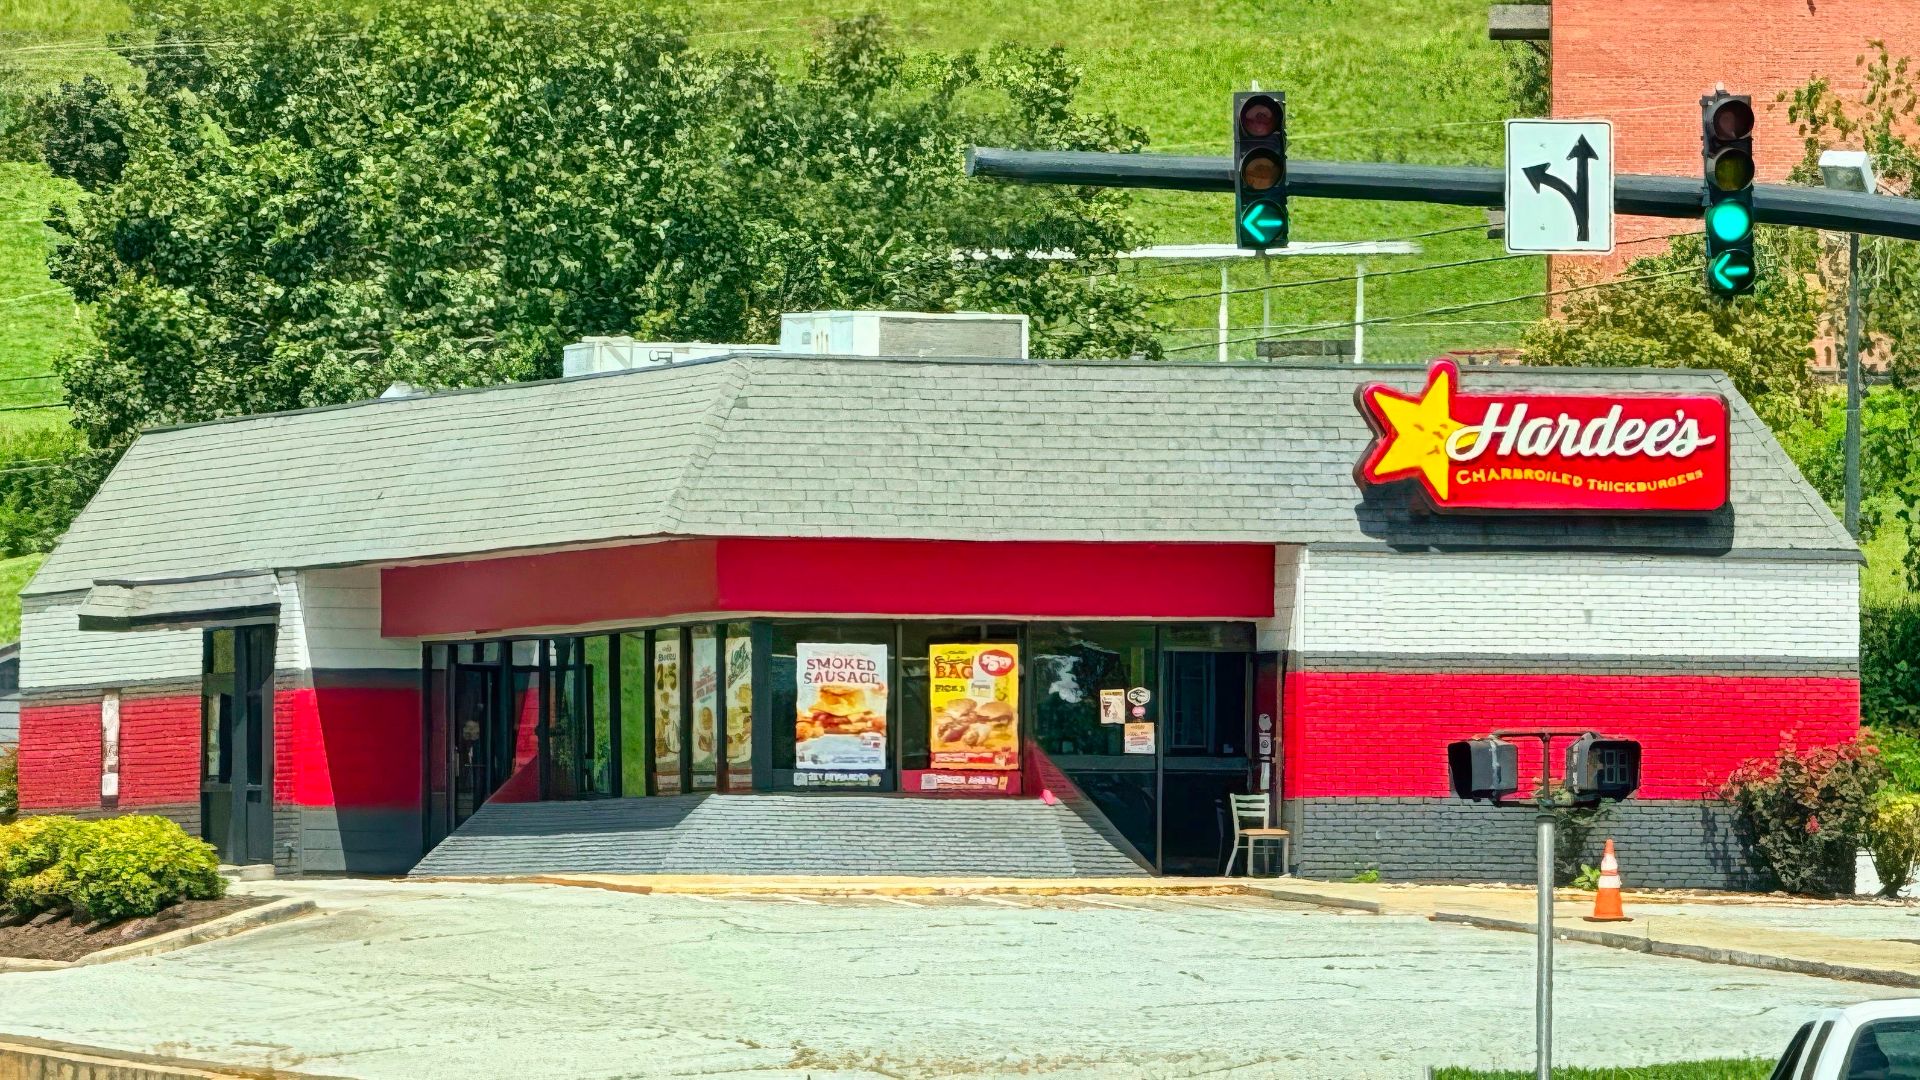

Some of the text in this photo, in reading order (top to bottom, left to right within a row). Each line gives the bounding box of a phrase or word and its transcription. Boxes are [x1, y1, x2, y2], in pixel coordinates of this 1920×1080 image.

[1445, 402, 1717, 461] Hardee's
[1456, 467, 1704, 493] CHARBROILED THICKBURGERS
[806, 657, 877, 672] SMOKED
[803, 670, 881, 685] SAUSAGE
